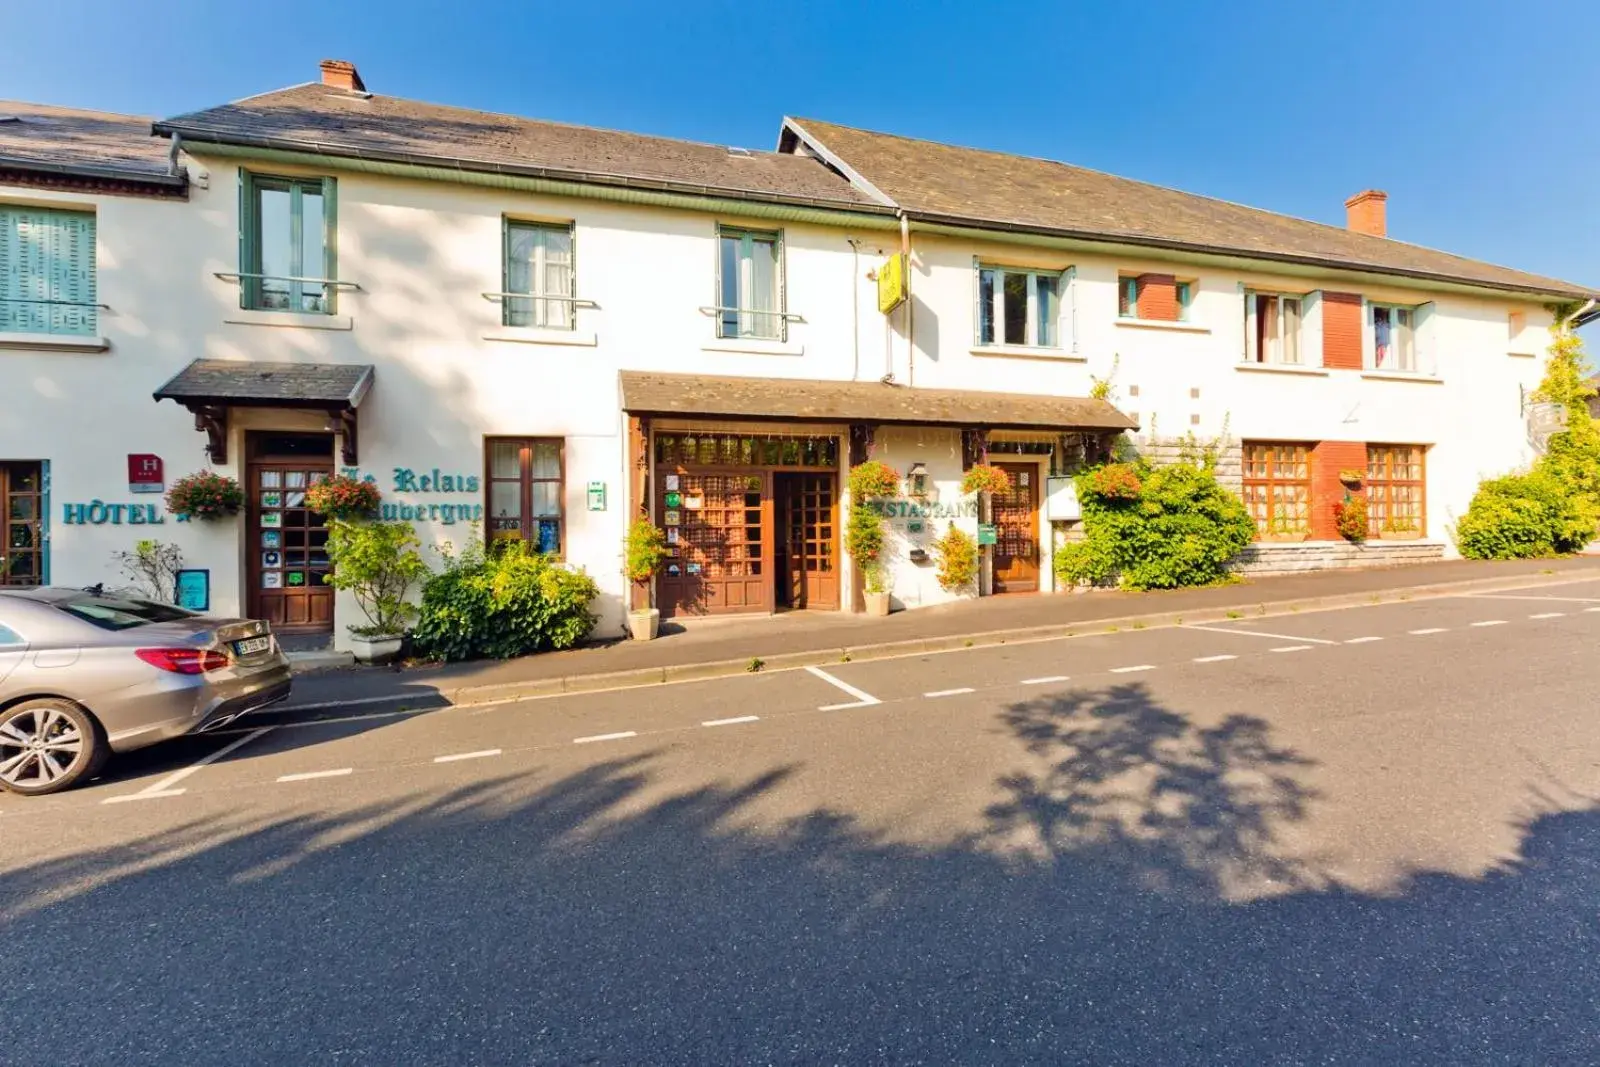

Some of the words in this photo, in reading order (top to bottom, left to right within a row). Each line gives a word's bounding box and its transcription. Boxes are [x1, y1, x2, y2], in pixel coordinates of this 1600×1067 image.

[143, 460, 157, 470] H
[392, 467, 480, 493] Relais
[63, 498, 165, 525] HÔTEL
